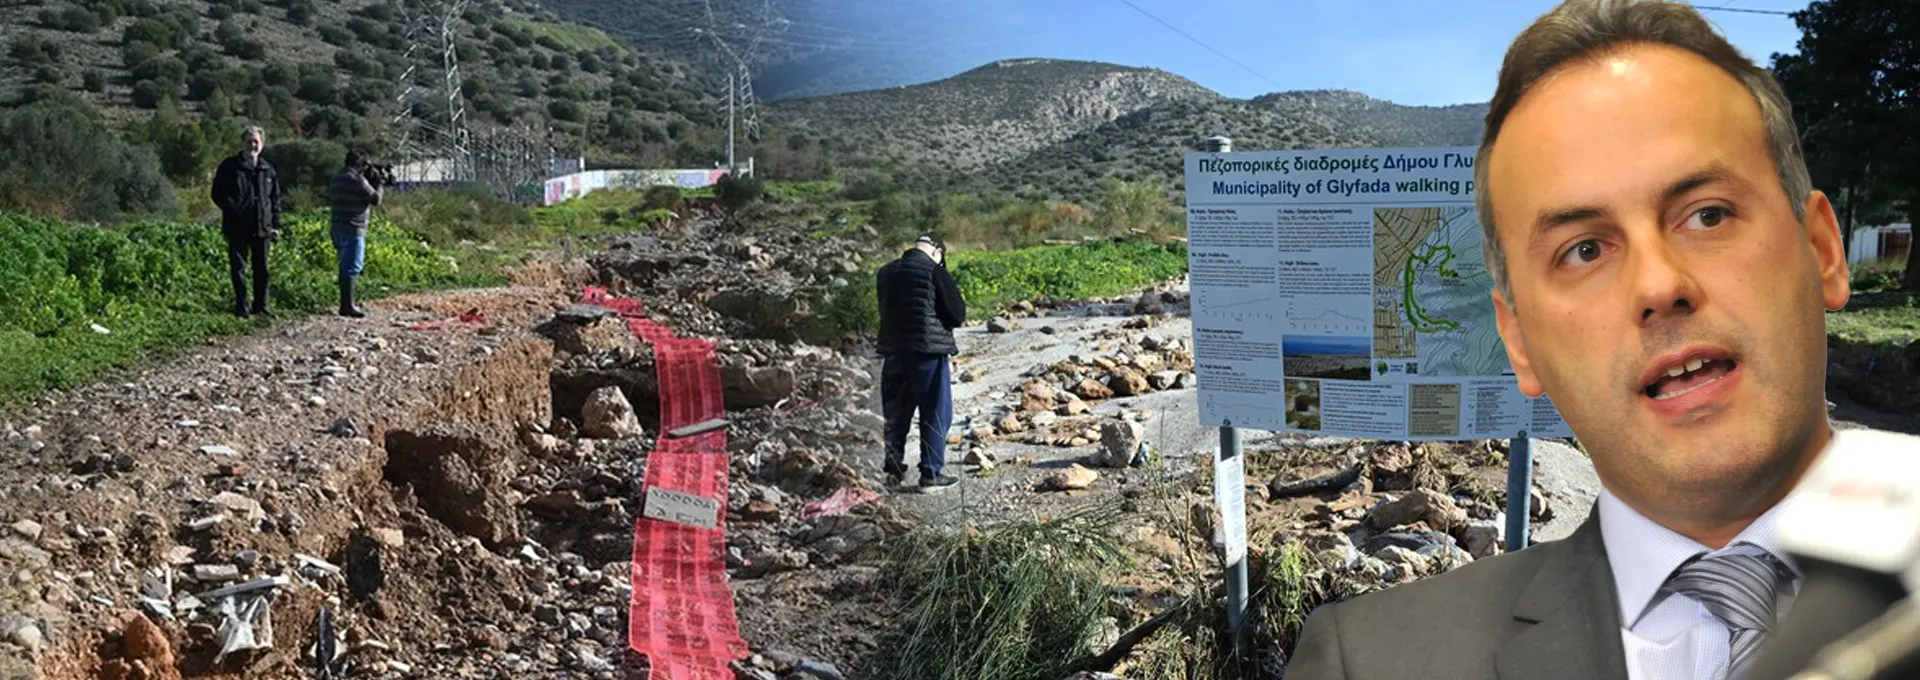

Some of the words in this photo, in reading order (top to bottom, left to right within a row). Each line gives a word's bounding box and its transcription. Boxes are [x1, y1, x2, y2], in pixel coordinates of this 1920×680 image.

[1199, 156, 1289, 175] Πεζοπορικές
[1293, 155, 1379, 173] διαδρομές
[1382, 154, 1438, 172] Δήμου
[1212, 181, 1301, 198] Municipality
[1305, 180, 1322, 194] of
[1326, 179, 1391, 197] Glyfada
[1395, 178, 1459, 195] walking
